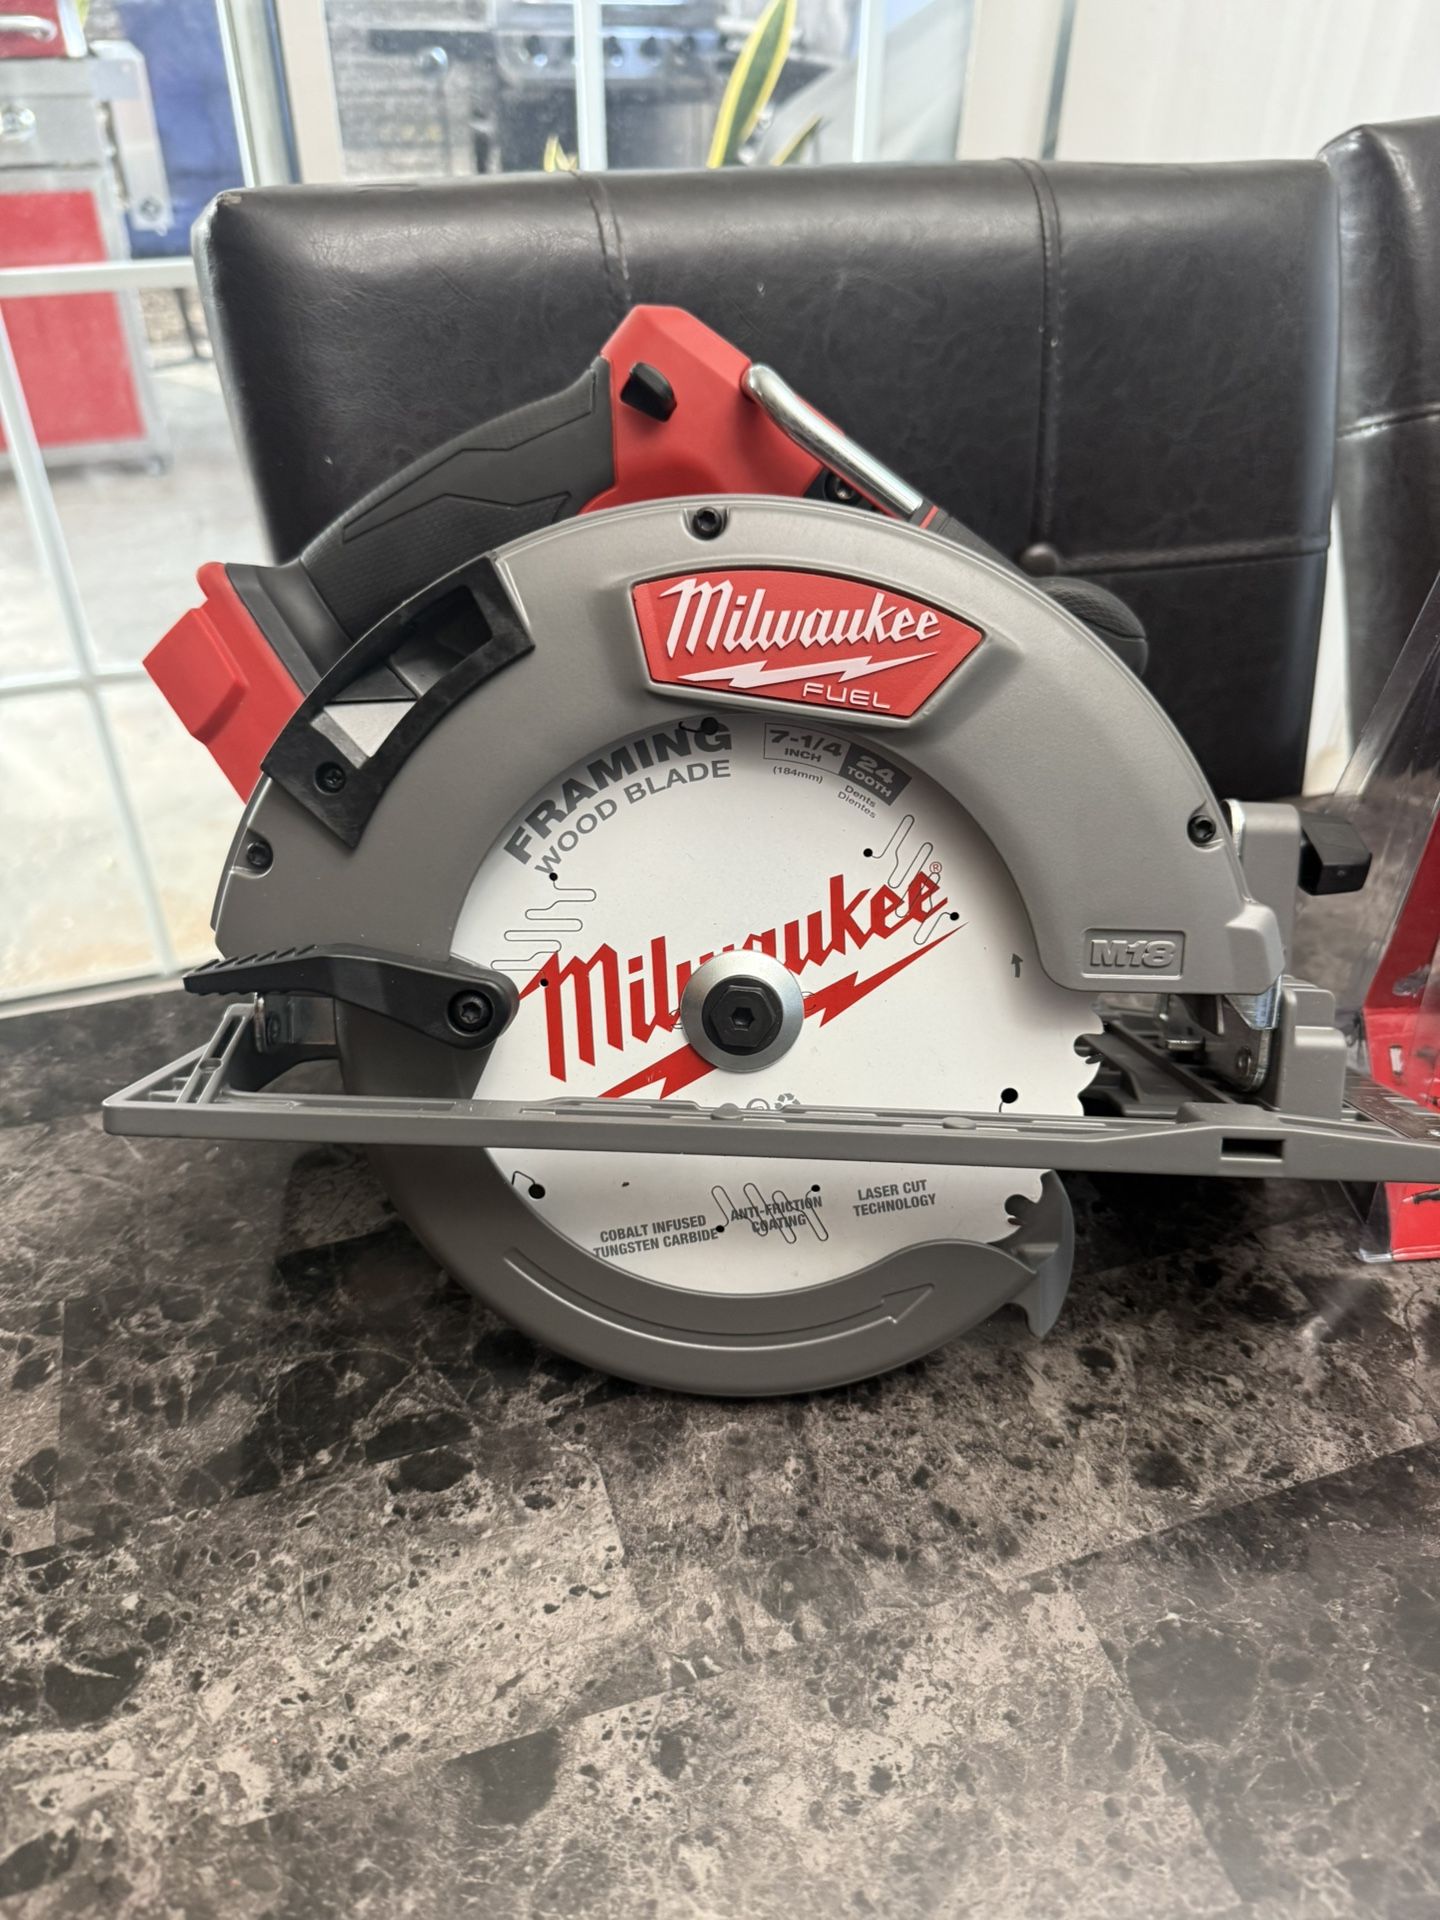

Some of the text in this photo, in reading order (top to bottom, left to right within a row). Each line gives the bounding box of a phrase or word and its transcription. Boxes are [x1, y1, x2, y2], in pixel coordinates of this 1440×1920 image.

[660, 578, 943, 659] Milwaukee
[802, 682, 891, 710] FUEL
[769, 729, 843, 758] 7-1/4
[784, 747, 822, 763] INCH
[772, 765, 824, 785] (184mm)
[847, 765, 892, 798] TOOTH
[855, 755, 896, 785] 24
[503, 723, 733, 865] FRAMING
[837, 791, 877, 819] Dientes
[844, 784, 877, 808] Dents
[534, 759, 732, 874] WOOD BLADE
[1090, 937, 1177, 969] M18
[857, 1179, 928, 1201] LASER CUT
[730, 1195, 824, 1222] ANTI-FRICTION
[852, 1193, 936, 1217] TECHNOLOGY
[599, 1214, 707, 1243] COBALT INFUSED
[751, 1213, 807, 1233] COATING
[592, 1227, 719, 1259] TUNGSTEN CARBIDE
